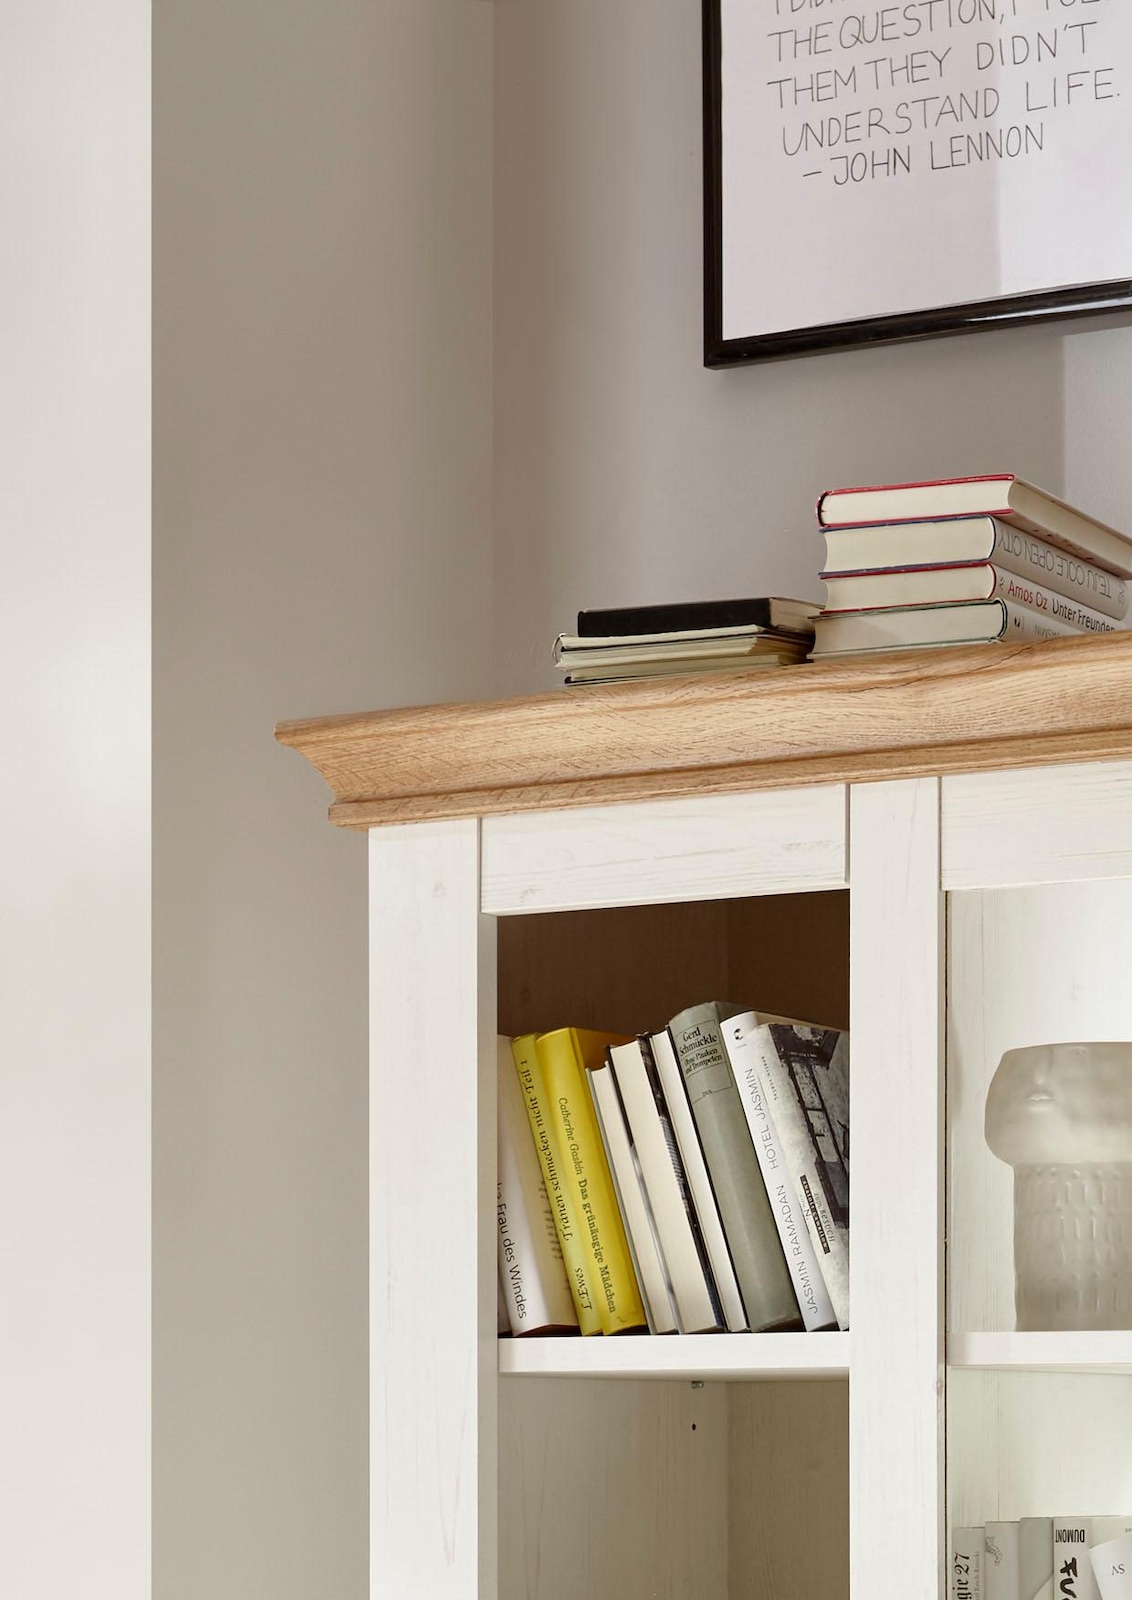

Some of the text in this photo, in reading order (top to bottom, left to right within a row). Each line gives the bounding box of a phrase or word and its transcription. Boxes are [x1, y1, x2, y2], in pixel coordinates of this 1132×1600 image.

[767, 22, 833, 62] THE
[839, 0, 1005, 48] QUESTION,
[767, 21, 1099, 109] THEM THEY DIDN'T
[782, 68, 1122, 156] UNDERSTAND LIFE.
[831, 147, 912, 187] JOHN
[930, 122, 1046, 171] LENNON
[997, 531, 1022, 557] CITY
[1024, 540, 1055, 572] OPEN
[1056, 554, 1085, 586] COLE
[1007, 580, 1034, 604] Amos
[1035, 591, 1049, 610] Oz
[1052, 598, 1077, 622] Unter
[683, 1026, 701, 1042] Gerd
[521, 1068, 535, 1094] Teil
[528, 1096, 544, 1127] nicht
[538, 1130, 561, 1192] schmecken
[558, 1097, 616, 1314] Catherine Gaskin Das grünäugige Mädchen
[744, 1067, 818, 1314] JASMIN RAMADAN HOTEL JASMIN
[497, 1203, 509, 1235] Frau
[503, 1236, 516, 1263] des
[509, 1263, 528, 1319] Windes
[1055, 1529, 1085, 1543] DUMONT
[954, 1551, 970, 1576] 27
[1111, 1563, 1126, 1576] SV
